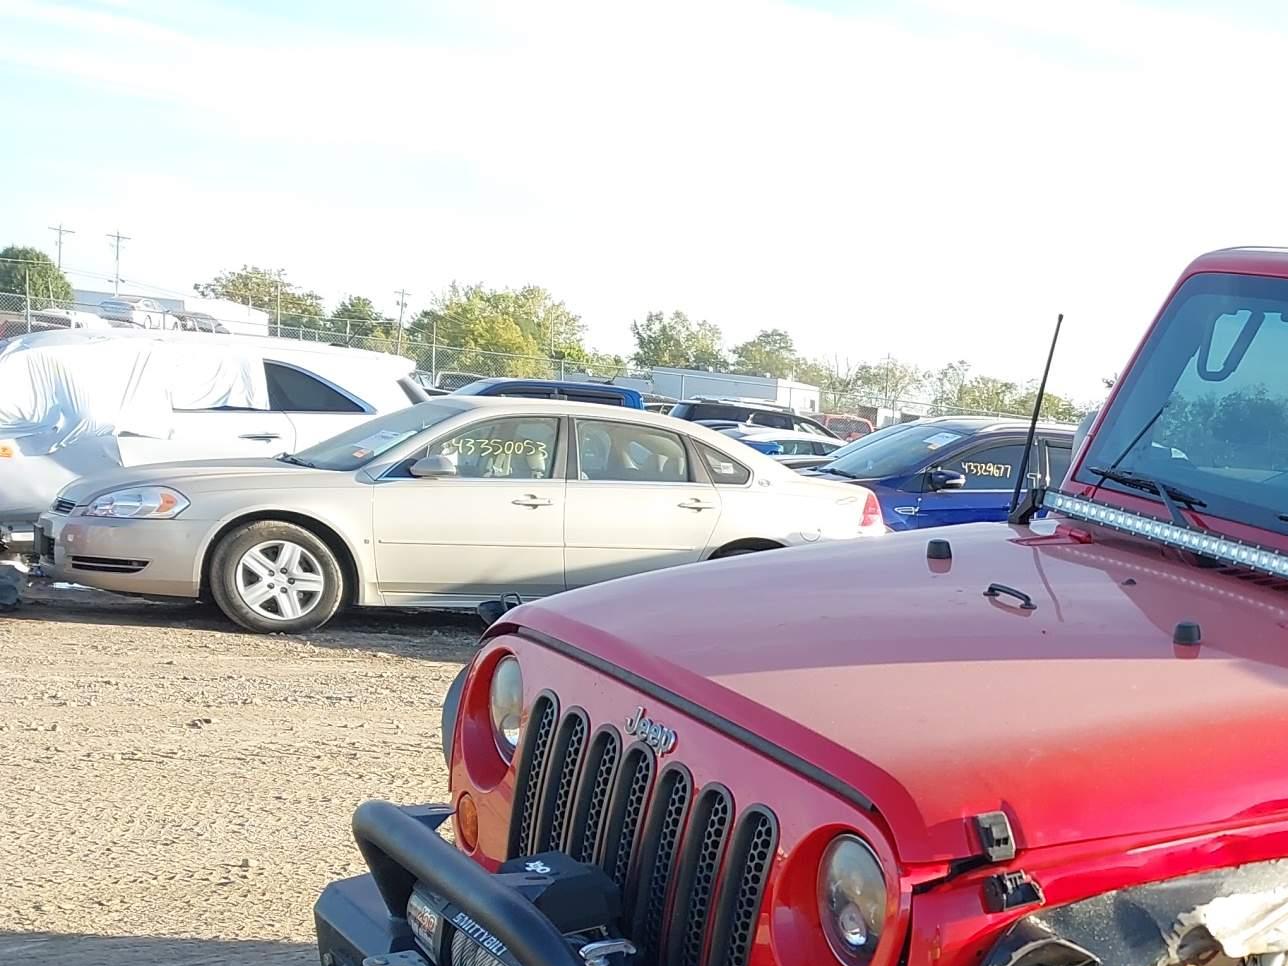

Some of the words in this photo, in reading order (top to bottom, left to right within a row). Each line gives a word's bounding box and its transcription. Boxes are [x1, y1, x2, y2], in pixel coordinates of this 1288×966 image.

[452, 438, 548, 459] 43350053
[624, 705, 677, 757] Jeep
[451, 912, 508, 956] SMITTYBILT
